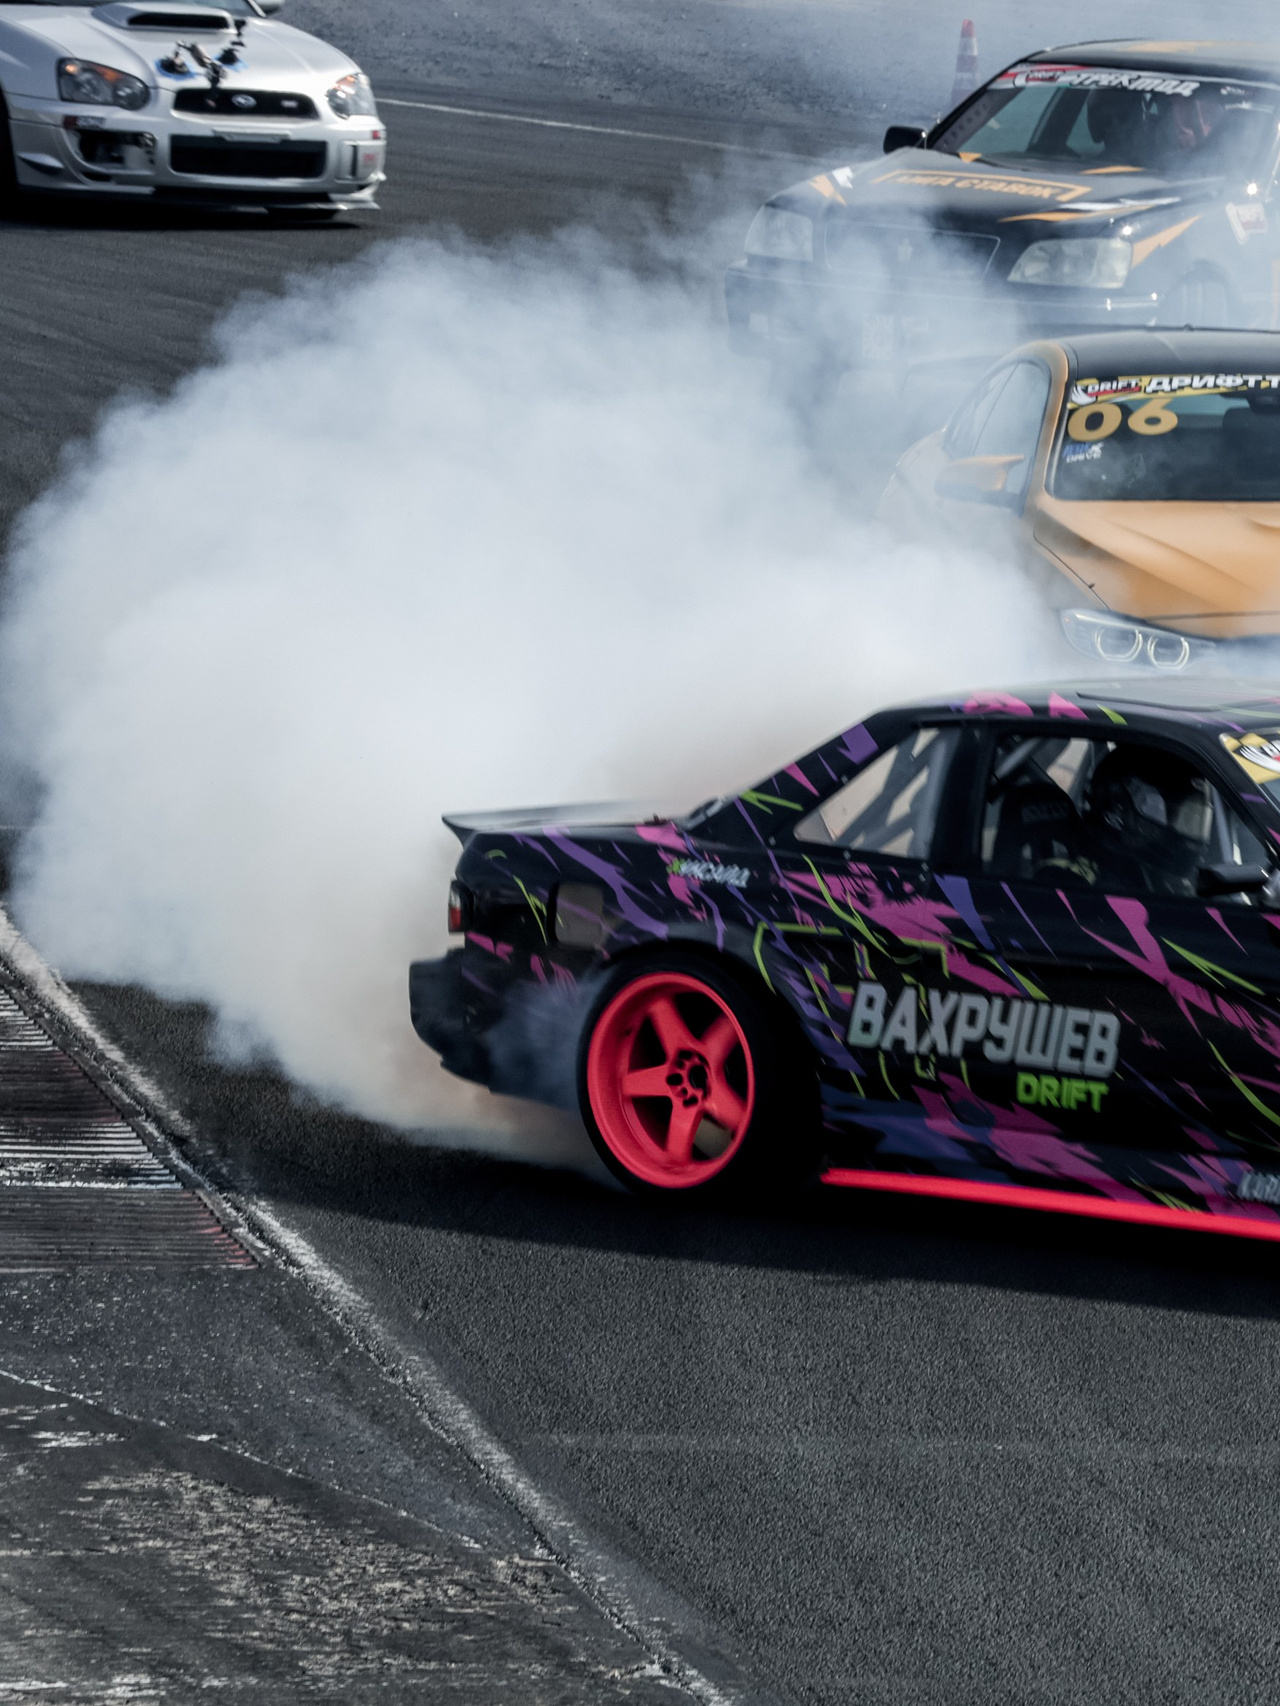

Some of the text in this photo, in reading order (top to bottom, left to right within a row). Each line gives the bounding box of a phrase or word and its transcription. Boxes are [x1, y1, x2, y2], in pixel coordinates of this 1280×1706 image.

[1087, 378, 1140, 397] DRIFT
[1145, 375, 1264, 394] ДРИФТ
[1067, 397, 1179, 442] 06
[848, 980, 1121, 1078] ВАХРУШЕВ
[1016, 1071, 1109, 1112] DRIFT
